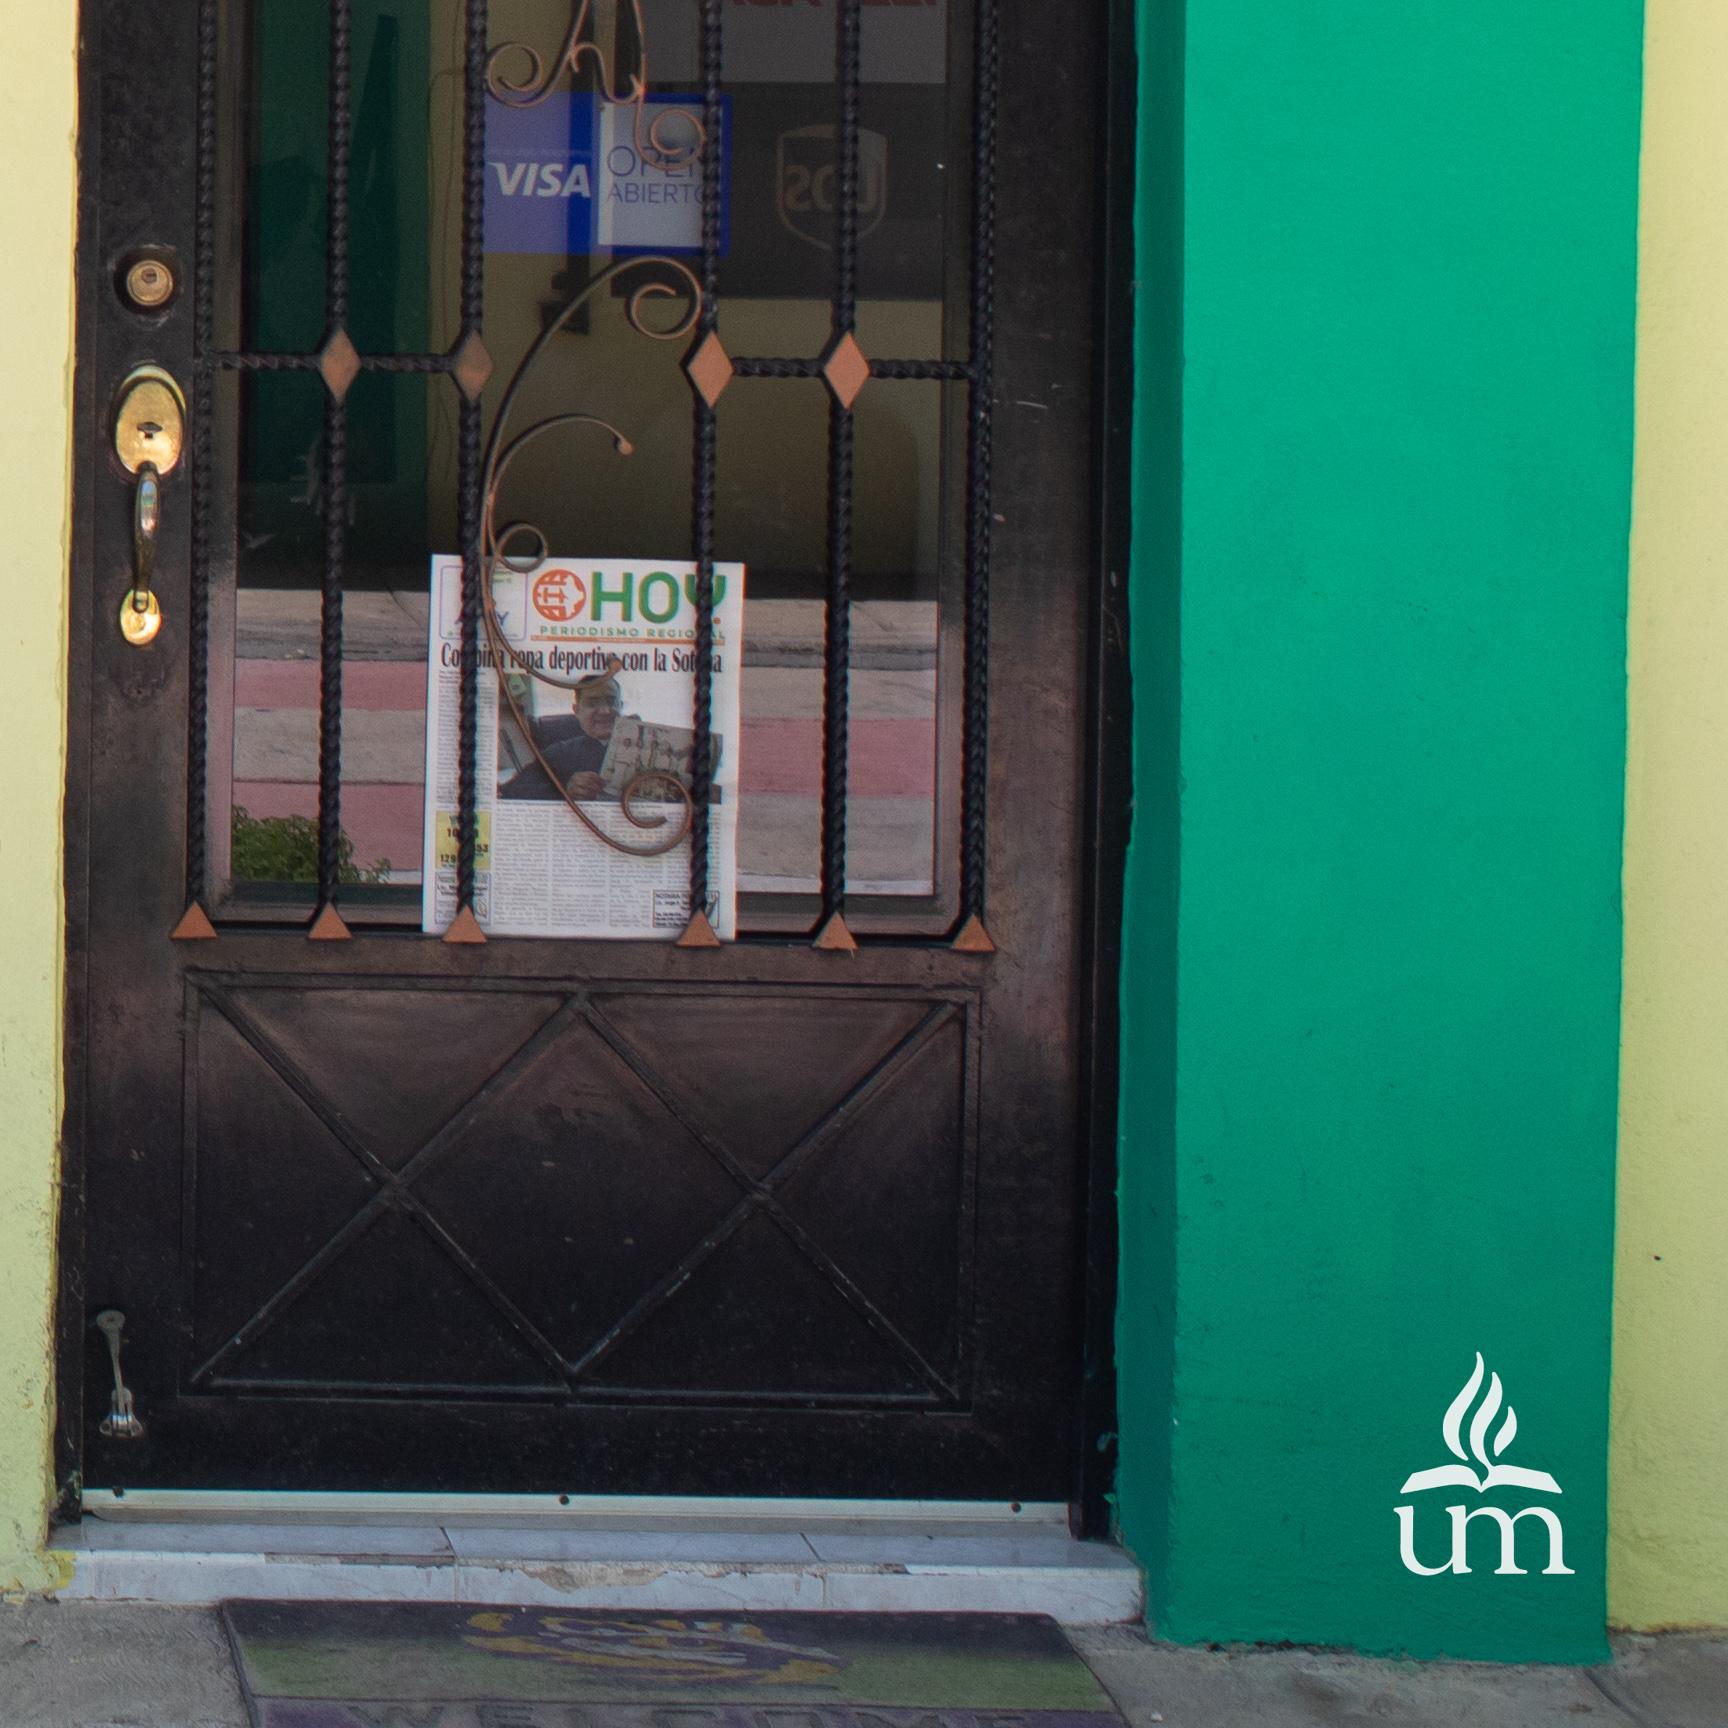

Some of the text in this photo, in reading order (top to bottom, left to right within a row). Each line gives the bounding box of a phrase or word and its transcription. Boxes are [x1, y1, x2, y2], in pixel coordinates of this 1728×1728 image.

[489, 161, 592, 198] VISA
[540, 626, 726, 639] PERIODISMO REGIOAL
[622, 652, 648, 671] con
[654, 647, 667, 672] la
